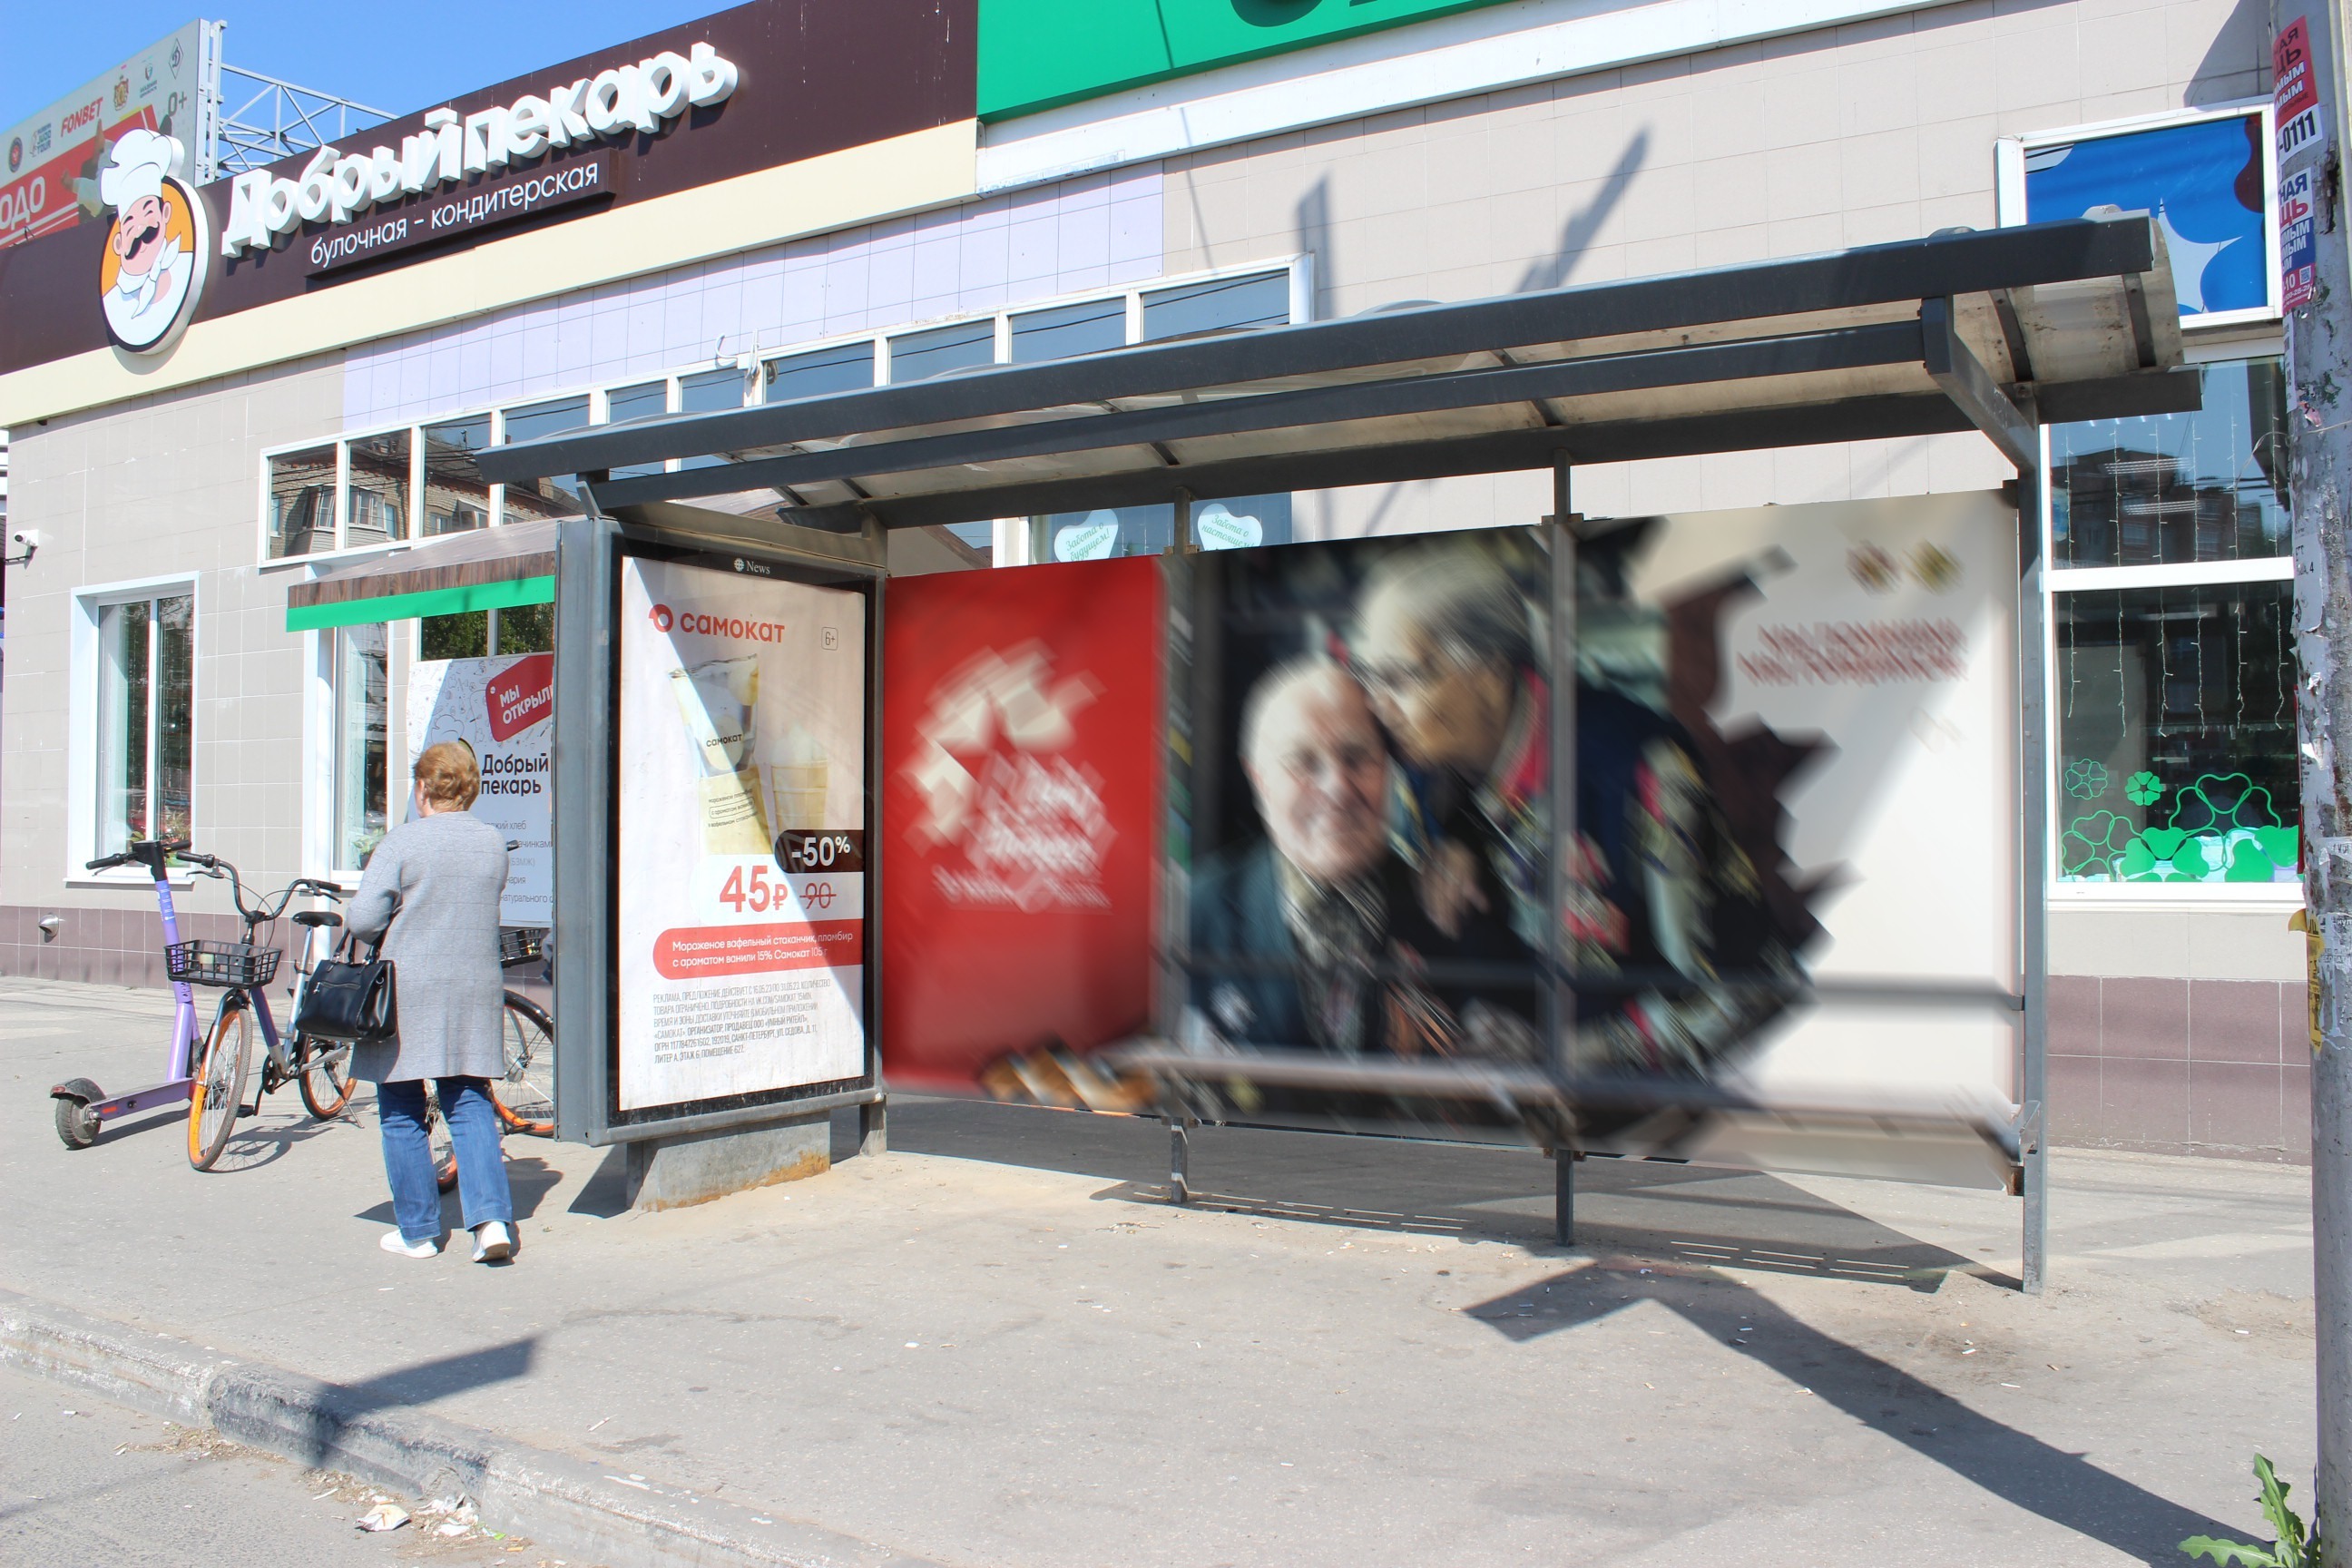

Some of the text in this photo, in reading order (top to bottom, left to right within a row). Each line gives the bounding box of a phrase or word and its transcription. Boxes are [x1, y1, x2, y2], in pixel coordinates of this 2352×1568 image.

[168, 91, 188, 117] 0+
[61, 96, 103, 137] FONBET
[2278, 111, 2316, 154] -0111
[221, 41, 739, 258] Добрый пекарь
[310, 218, 408, 268] булочная
[431, 161, 599, 230] кондитерская
[1211, 514, 1243, 534] Забота
[1065, 526, 1098, 552] Забота
[746, 560, 770, 574] News
[681, 612, 785, 642] самокат
[825, 631, 836, 645] 6+
[499, 684, 521, 707] МЫ
[706, 734, 742, 748] самокат
[482, 753, 549, 776] Добрый
[481, 779, 542, 797] пекарь
[509, 820, 526, 829] хлеб
[791, 836, 851, 867] -50%
[803, 882, 833, 909] 90
[672, 931, 853, 953] Мороженое вафельный стаканчик, пломбир
[672, 959, 679, 967] с
[680, 956, 725, 968] ароматом
[726, 953, 756, 964] ванили
[757, 950, 773, 961] 15%
[774, 947, 809, 960] Самокат
[811, 947, 823, 957] 105
[682, 988, 720, 1001] ПРЕДЛОЖЕНИЕ
[721, 985, 749, 997] ДЕЙСТВУЕТ
[800, 978, 831, 990] КОЛИЧЕСТВО
[654, 1004, 675, 1015] ТОВАРА
[710, 997, 748, 1010] ПОДРОБНОСТИ
[654, 1016, 673, 1027] ВРЕМЯ
[679, 1014, 694, 1025] ЗОНЫ
[695, 1012, 722, 1024] ДОСТАВКИ
[723, 1007, 750, 1021] УТОЧНЯЙТЕ
[755, 1004, 785, 1016] МОБИЛЬНОМ
[786, 1001, 818, 1014] ПРИЛОЖЕНИИ
[724, 1019, 753, 1032] ПРОДАВЕЦ
[753, 1019, 764, 1028] ООО
[654, 1041, 670, 1052] ОГРН
[654, 1053, 672, 1064] ЛИТЕР
[680, 1051, 695, 1062] ЭТАЖ
[701, 1045, 733, 1058] ПОМЕЩЕНИЕ
